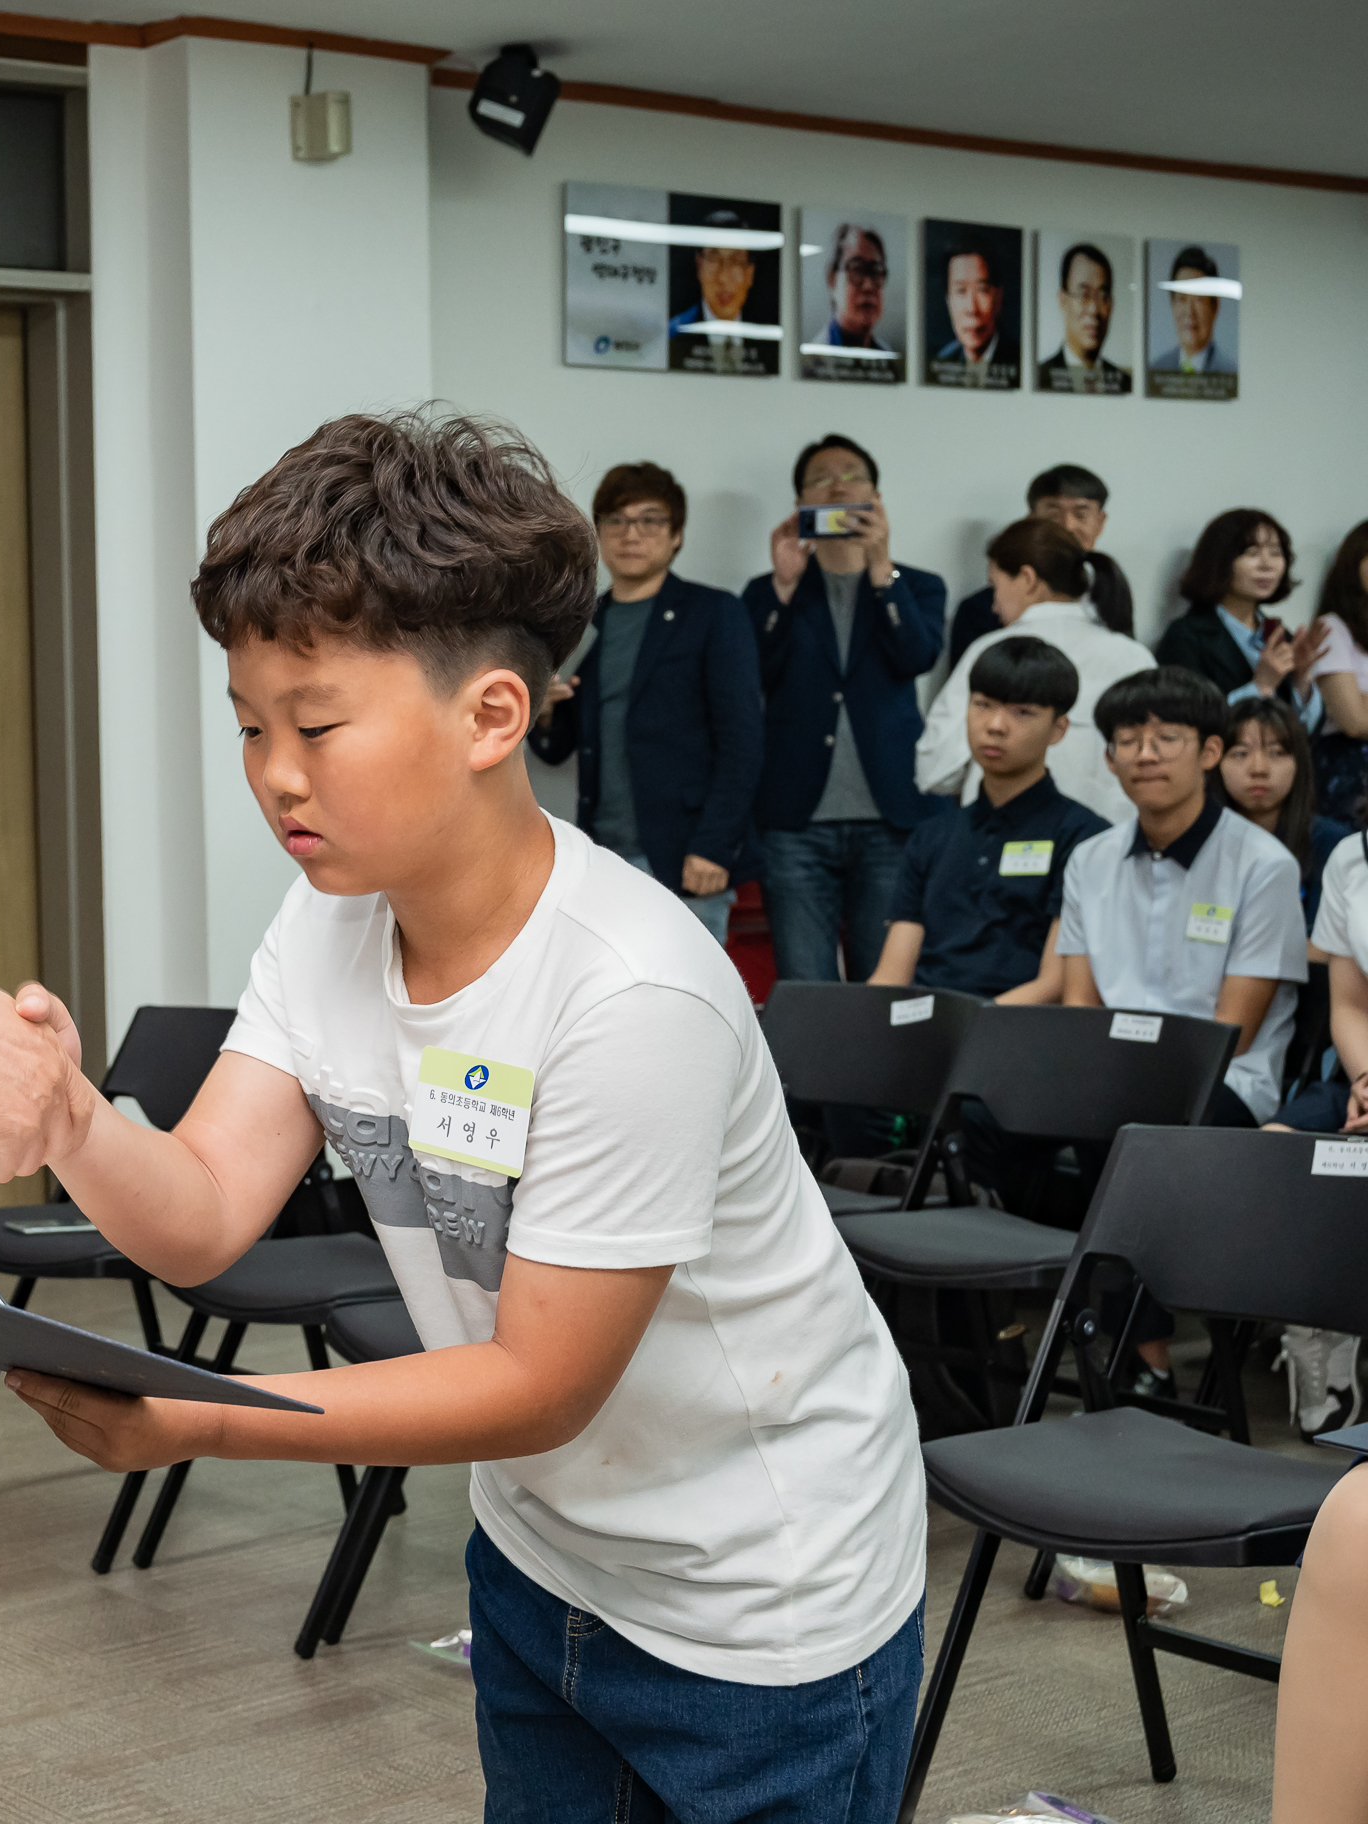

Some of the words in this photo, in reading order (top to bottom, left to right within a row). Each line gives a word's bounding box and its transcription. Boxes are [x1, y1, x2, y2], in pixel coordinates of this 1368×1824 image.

[429, 1089, 436, 1100] 6.
[440, 1091, 487, 1113] 동의초등학교
[489, 1104, 516, 1121] 제6학년
